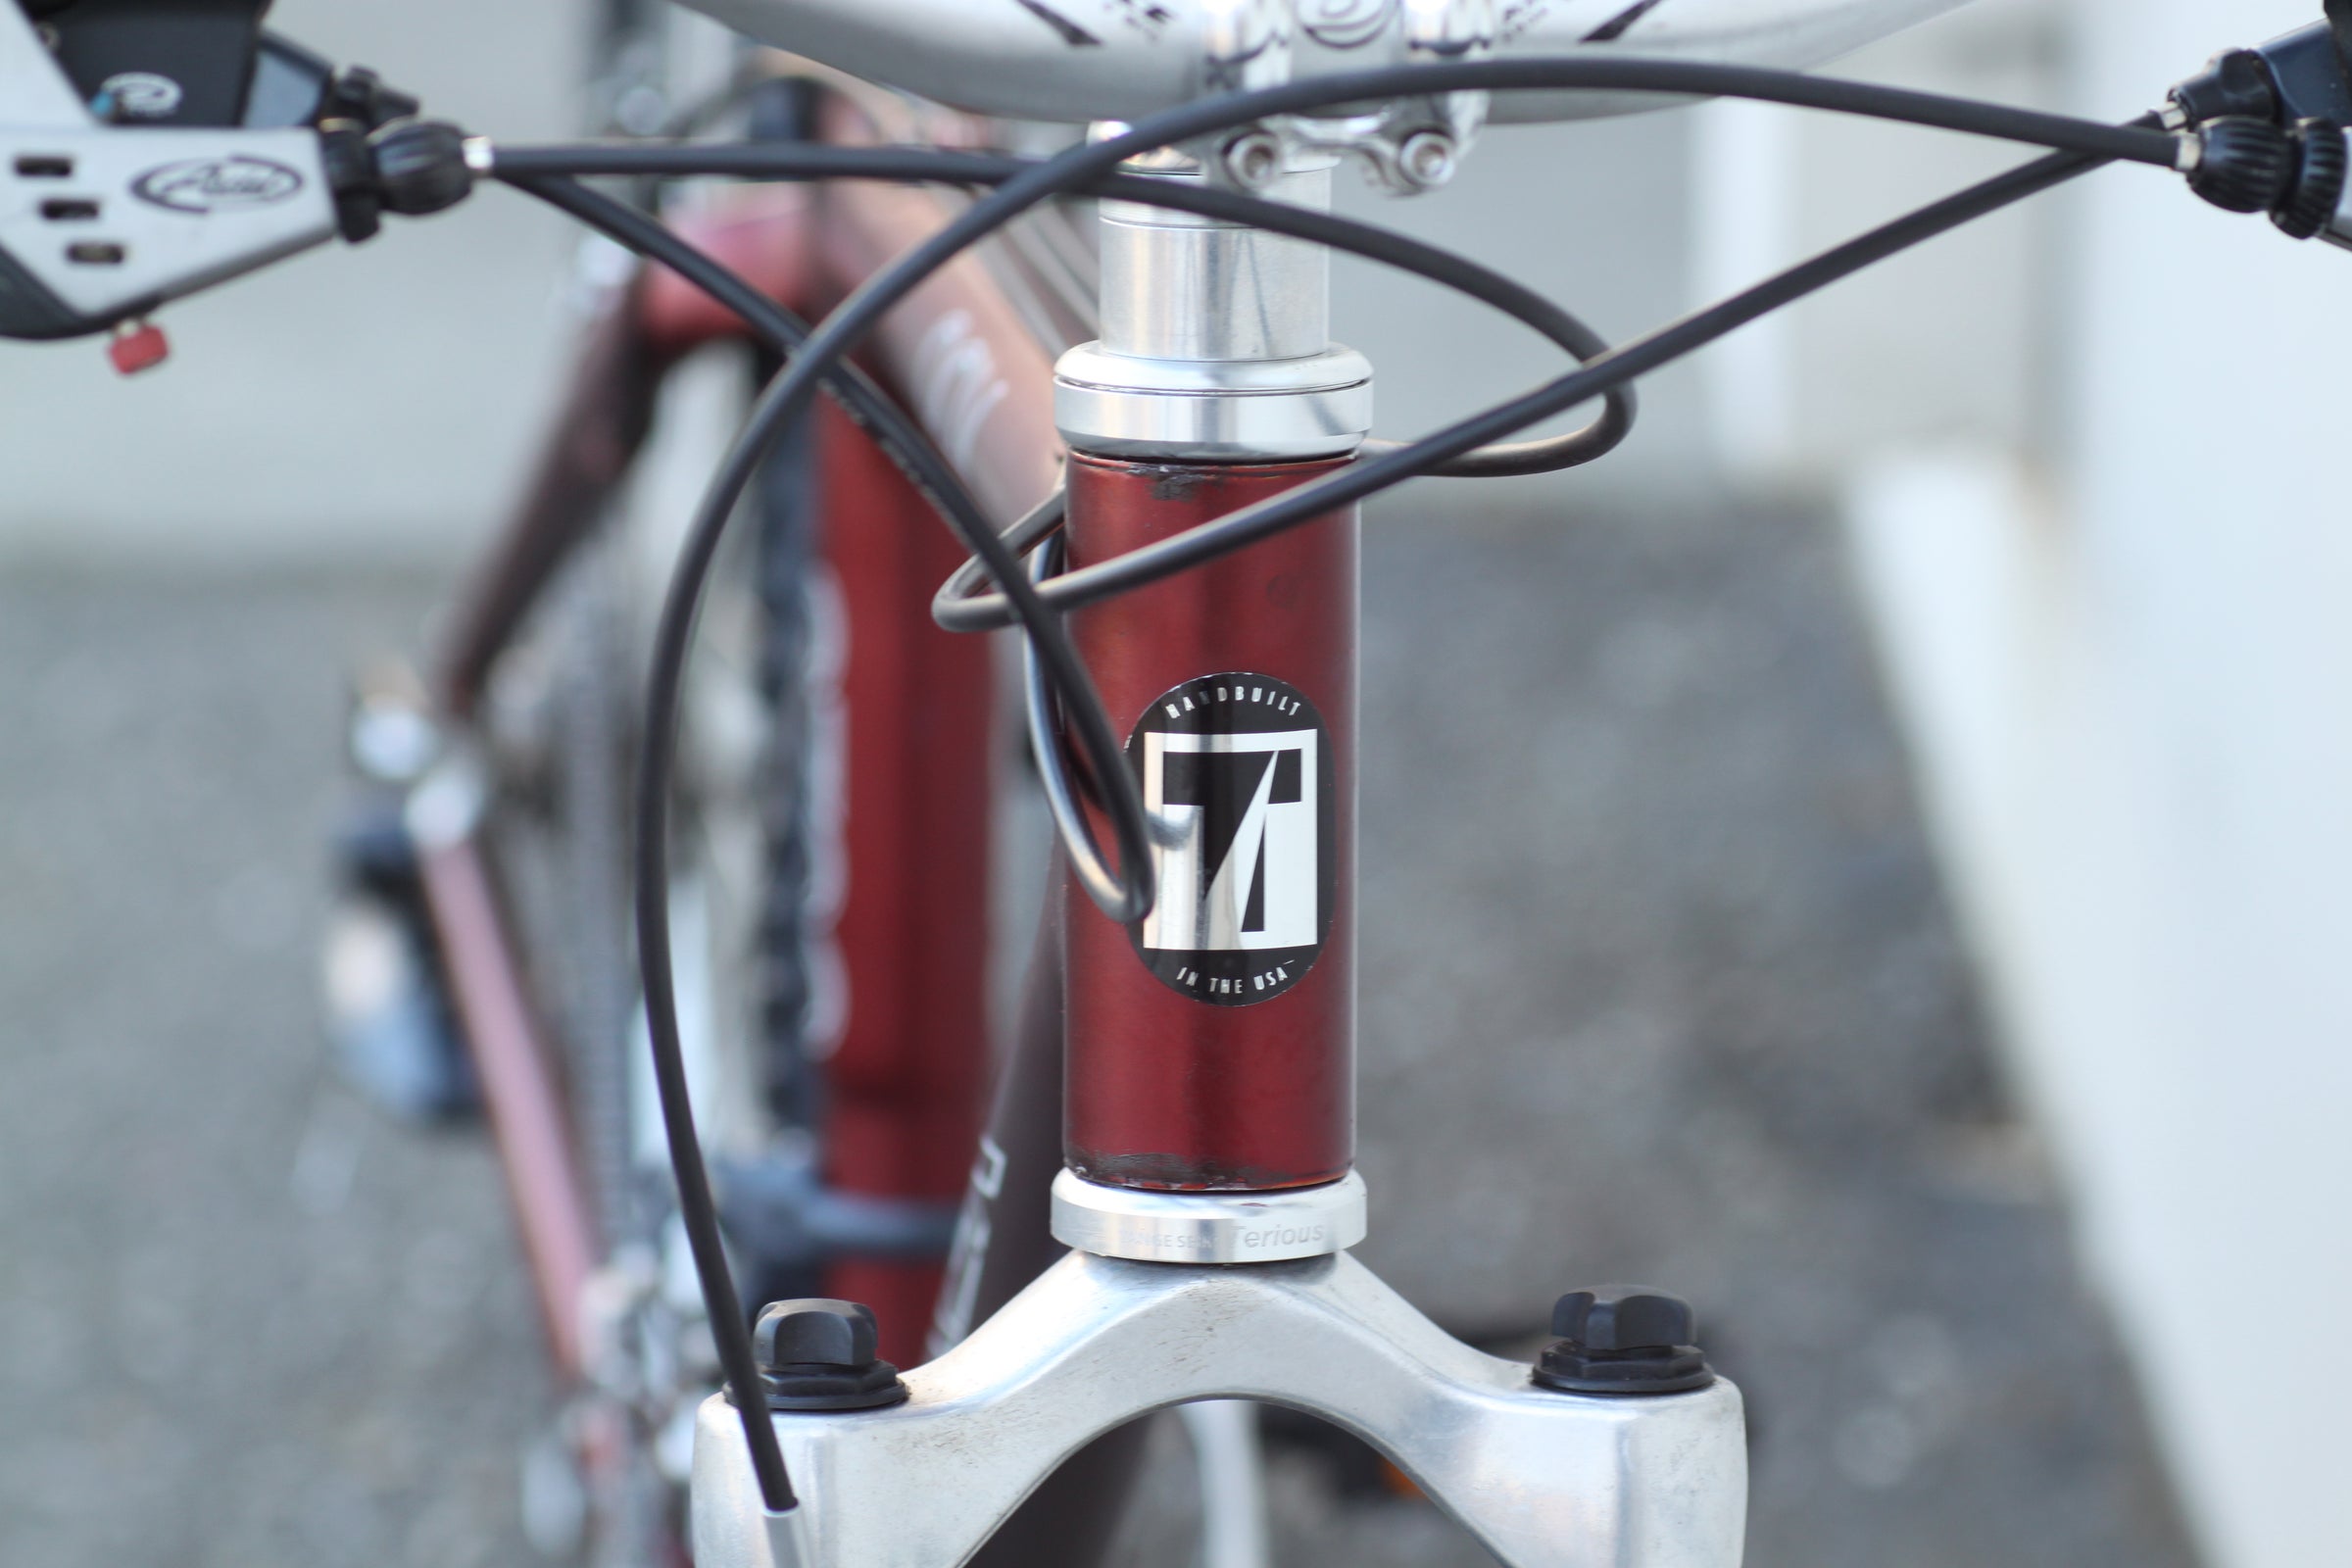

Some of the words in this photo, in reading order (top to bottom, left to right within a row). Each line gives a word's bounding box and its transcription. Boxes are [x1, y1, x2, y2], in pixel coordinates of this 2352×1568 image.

[1165, 685, 1301, 719] HANDBUILT
[1176, 966, 1200, 987] IN
[1209, 977, 1243, 994] THE
[1253, 966, 1288, 991] USA
